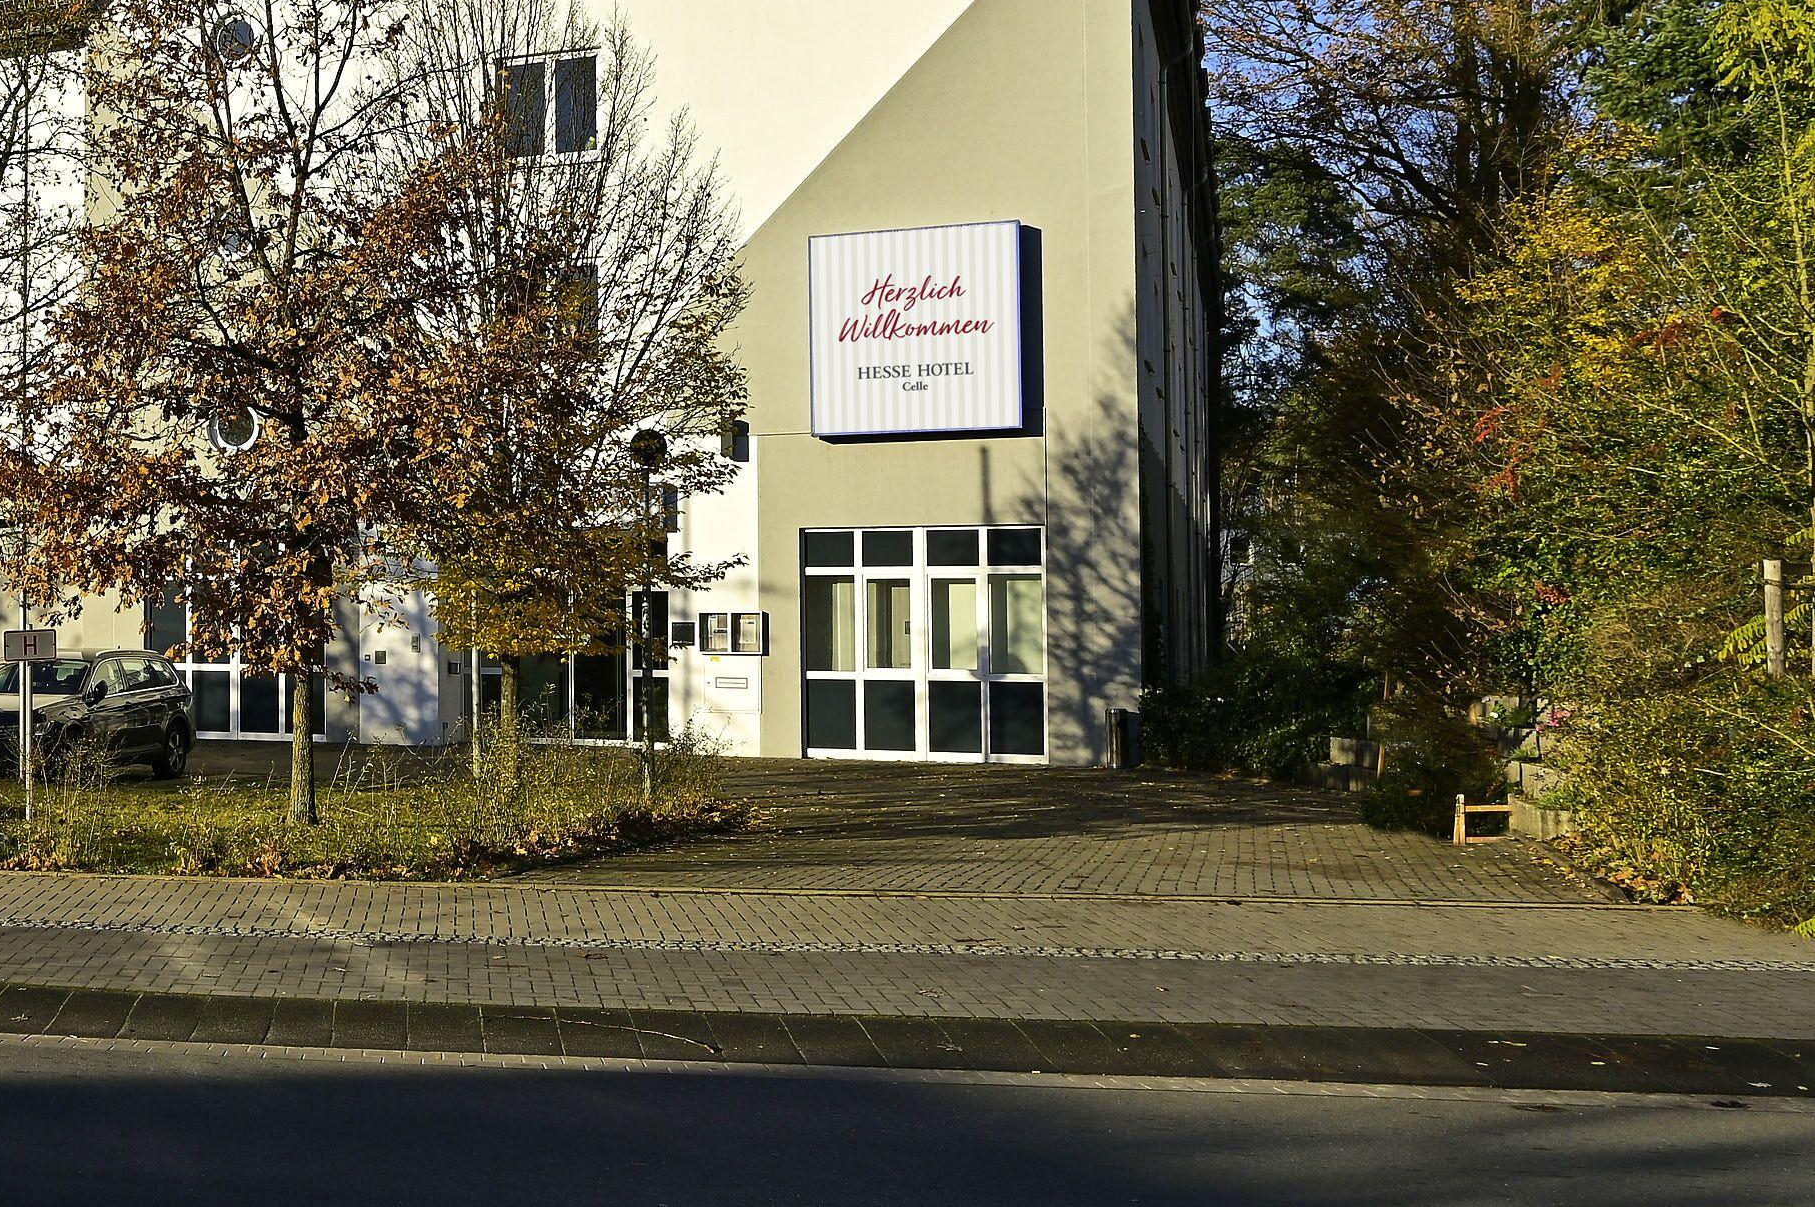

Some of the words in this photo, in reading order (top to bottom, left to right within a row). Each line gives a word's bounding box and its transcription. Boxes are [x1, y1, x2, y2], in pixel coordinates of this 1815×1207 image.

[861, 274, 966, 311] Herzlich
[838, 309, 994, 342] Willkommen
[857, 365, 911, 380] HESSE
[918, 362, 974, 377] HOTEL
[902, 381, 929, 391] Celle
[23, 635, 37, 656] H
